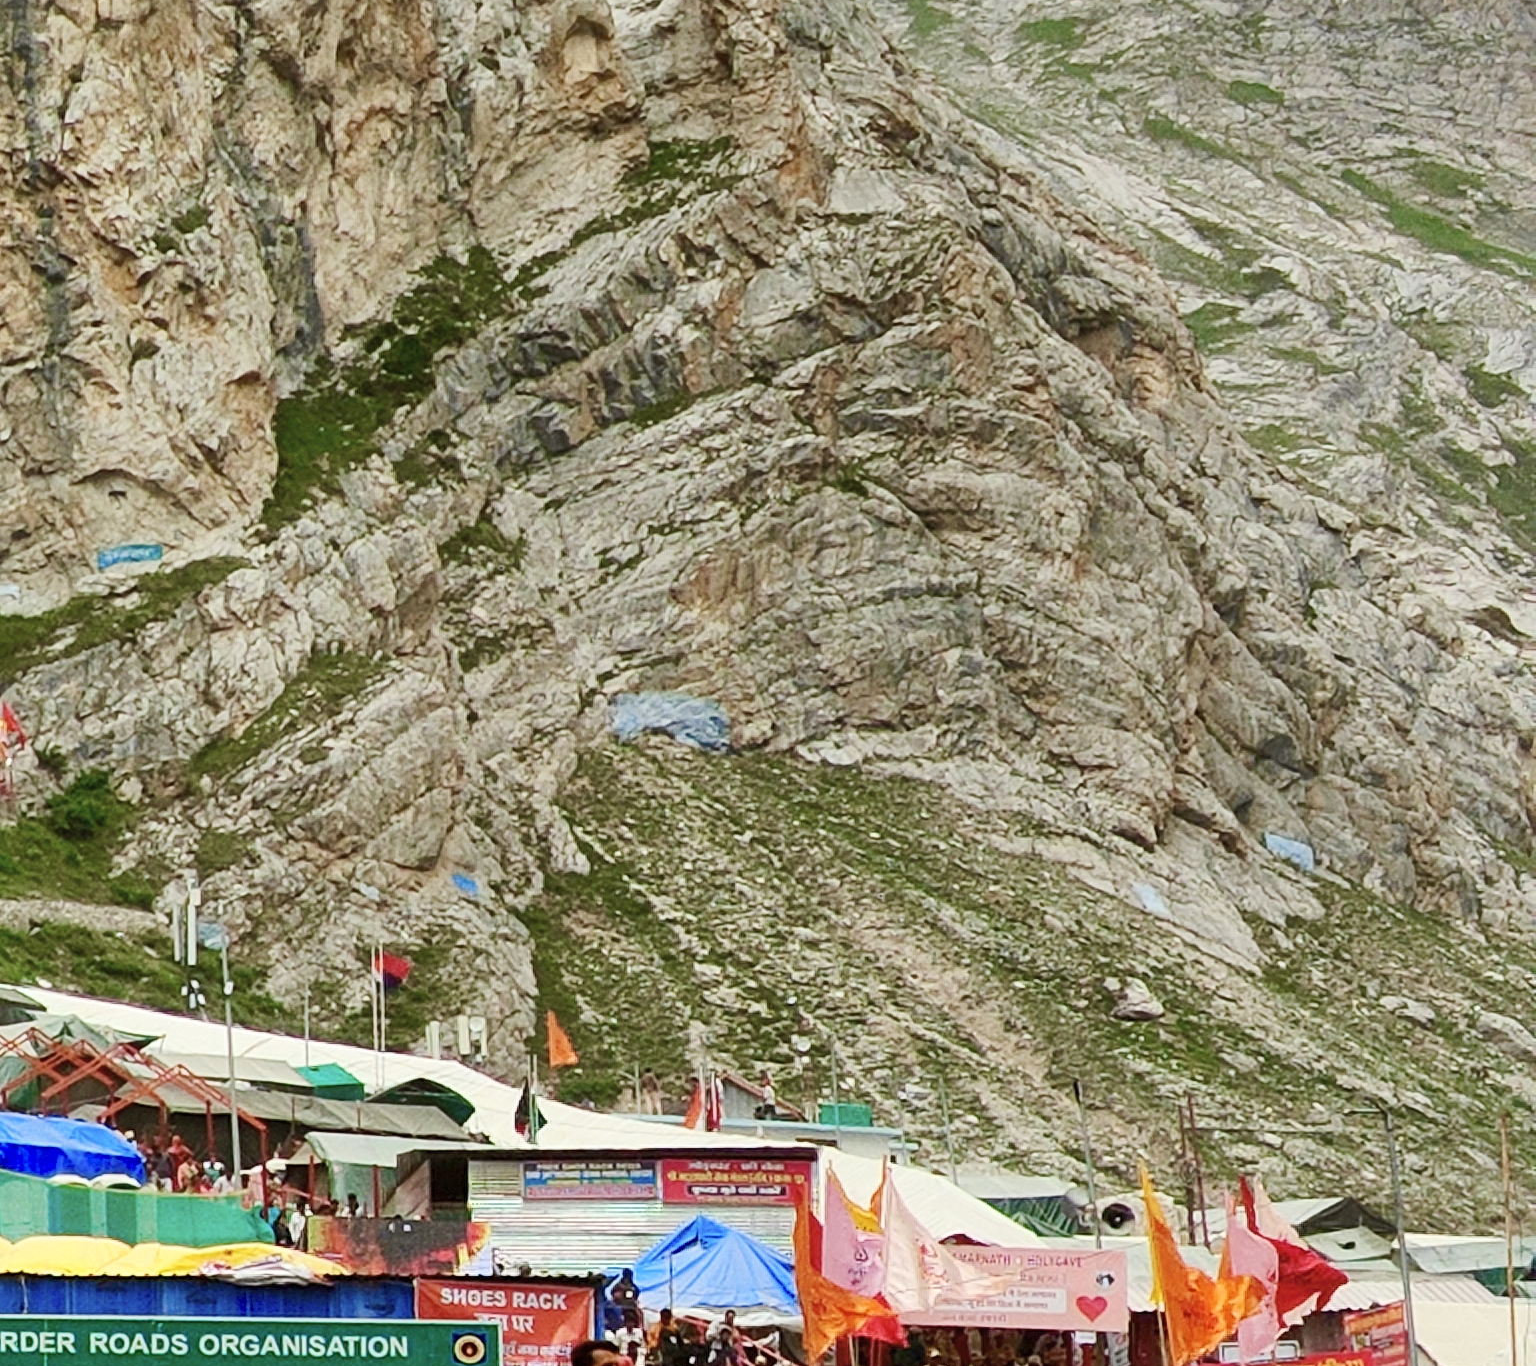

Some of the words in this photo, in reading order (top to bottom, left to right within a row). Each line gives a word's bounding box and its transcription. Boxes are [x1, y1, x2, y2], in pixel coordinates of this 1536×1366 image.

[440, 1287, 508, 1308] SHOES
[512, 1291, 568, 1311] RACK
[89, 1332, 189, 1356] ROADS
[198, 1333, 409, 1358] ORGANISATION
